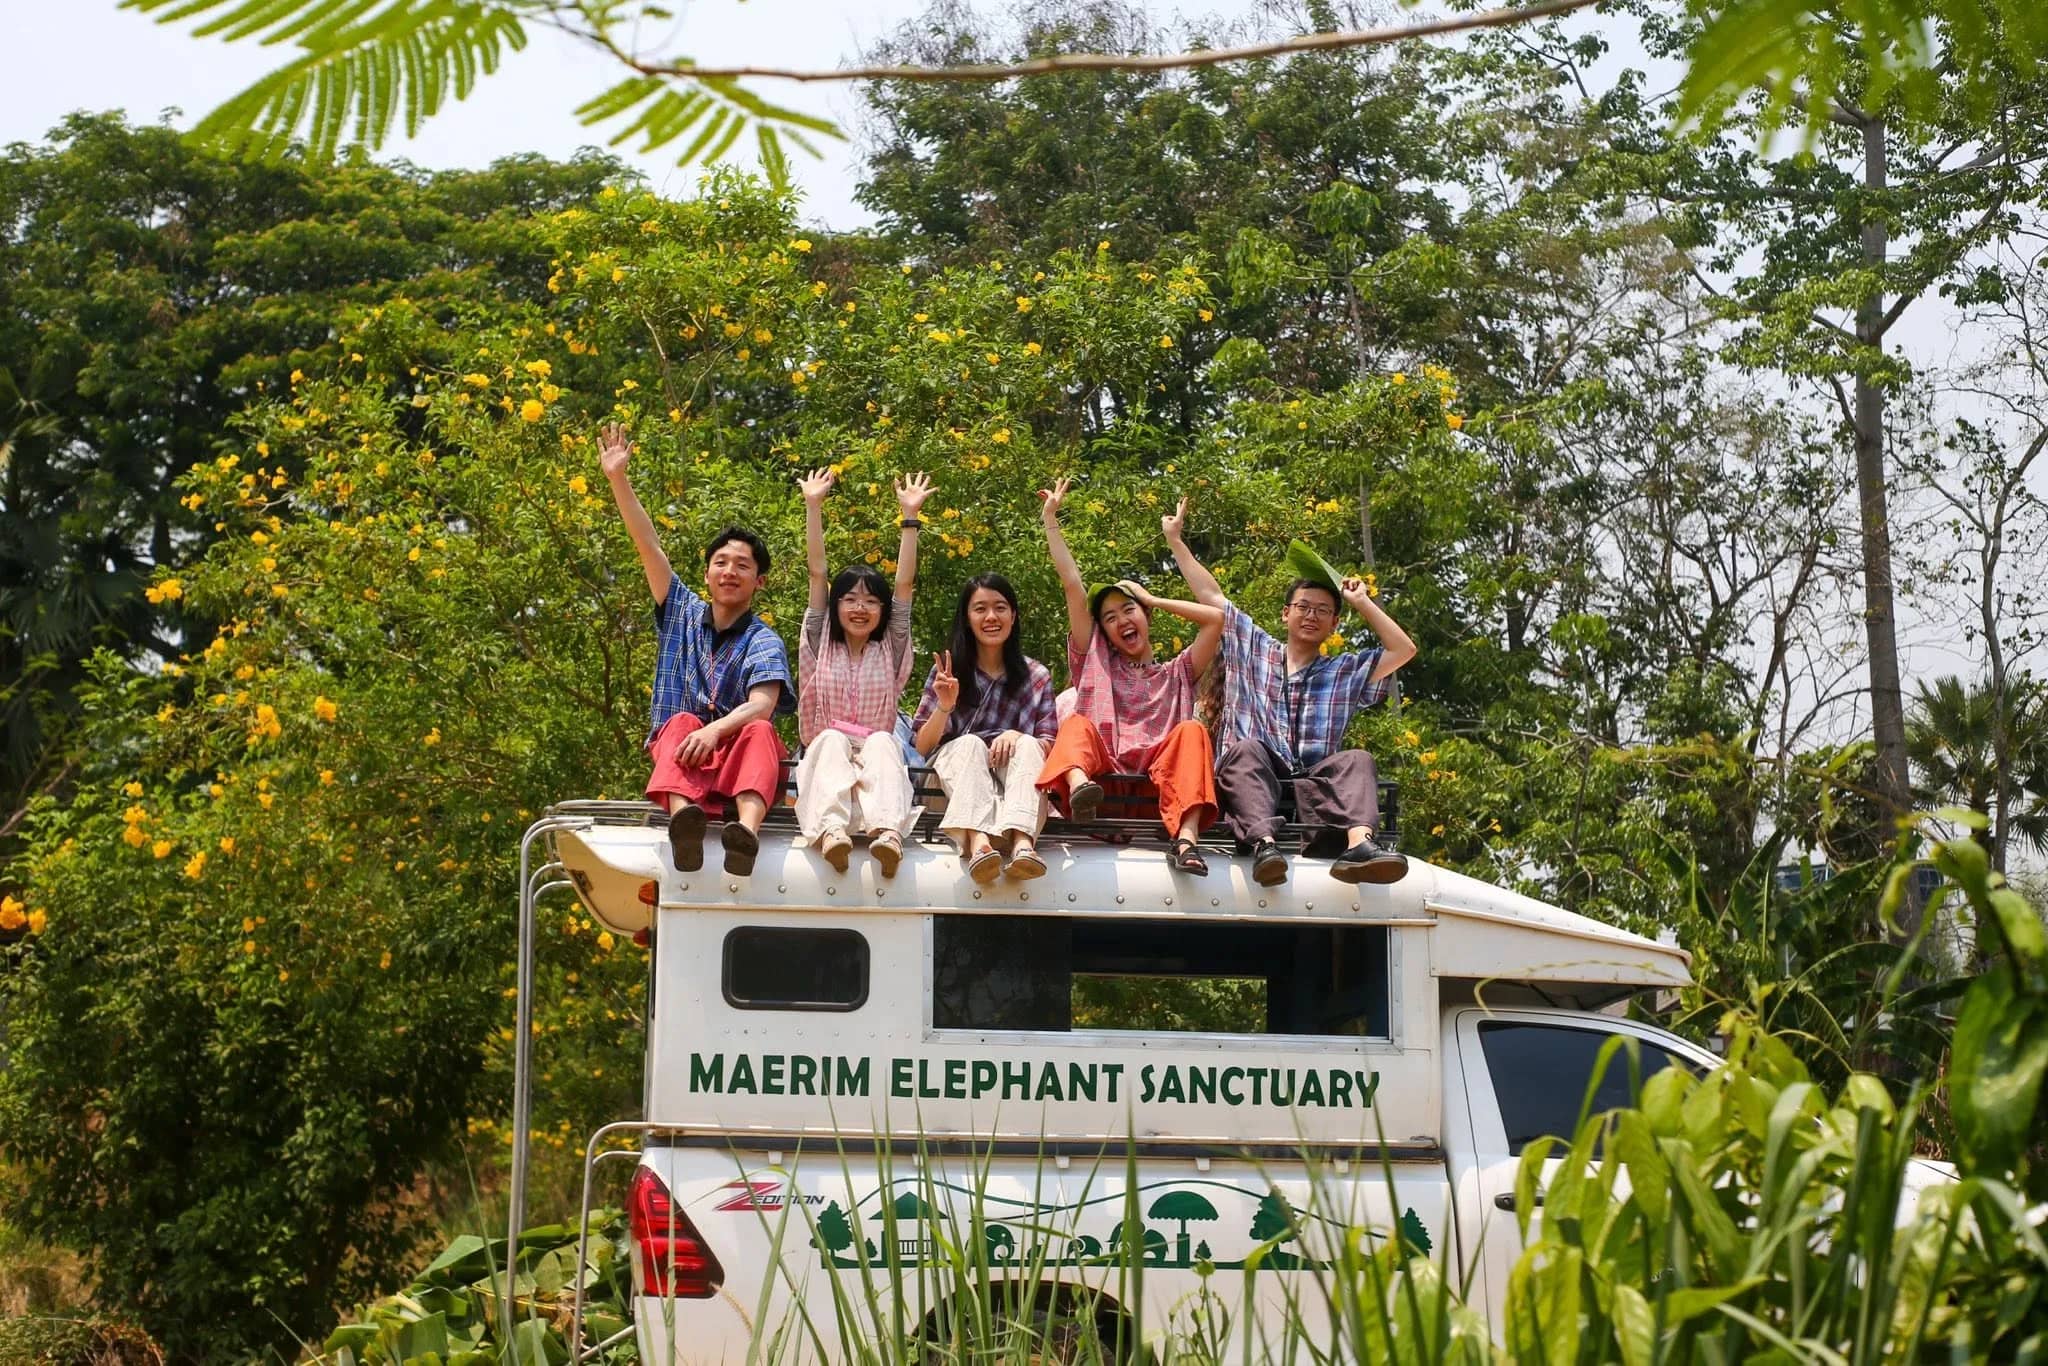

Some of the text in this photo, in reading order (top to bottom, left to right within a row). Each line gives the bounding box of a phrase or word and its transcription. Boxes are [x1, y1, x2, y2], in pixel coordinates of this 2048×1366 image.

[690, 1053, 1380, 1108] MAERIM ELEPHANT SANCTUARY
[750, 1195, 825, 1205] EDIION
